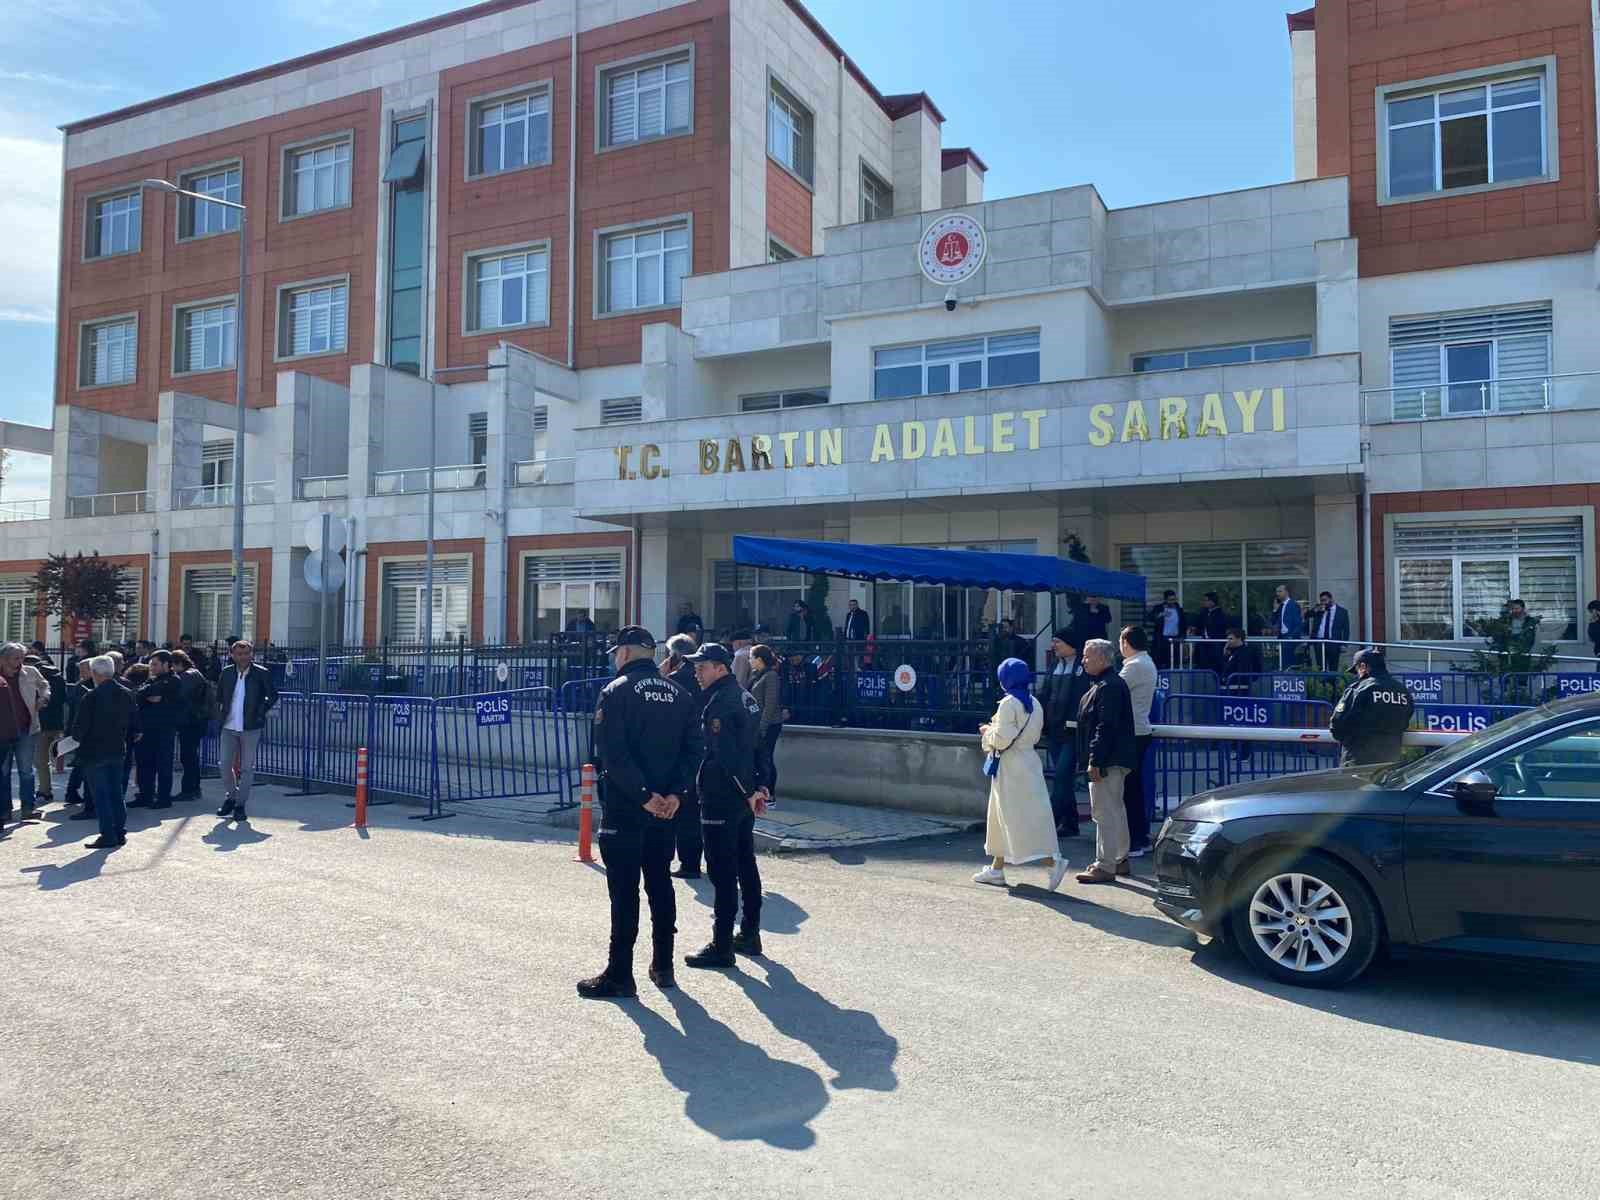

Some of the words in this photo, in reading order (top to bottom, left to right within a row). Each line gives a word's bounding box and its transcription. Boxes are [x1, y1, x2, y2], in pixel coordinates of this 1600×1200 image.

[613, 442, 671, 481] T.C.
[699, 428, 844, 475] BARTIN
[870, 409, 1047, 463] ADALET
[1088, 387, 1287, 447] SARAYI
[1273, 677, 1305, 692] POLİS
[1405, 676, 1441, 692] POLİS
[476, 697, 509, 714] POLİS
[1373, 691, 1408, 705] POLİS
[1223, 704, 1268, 724] POLİS
[1427, 712, 1487, 732] POLİS
